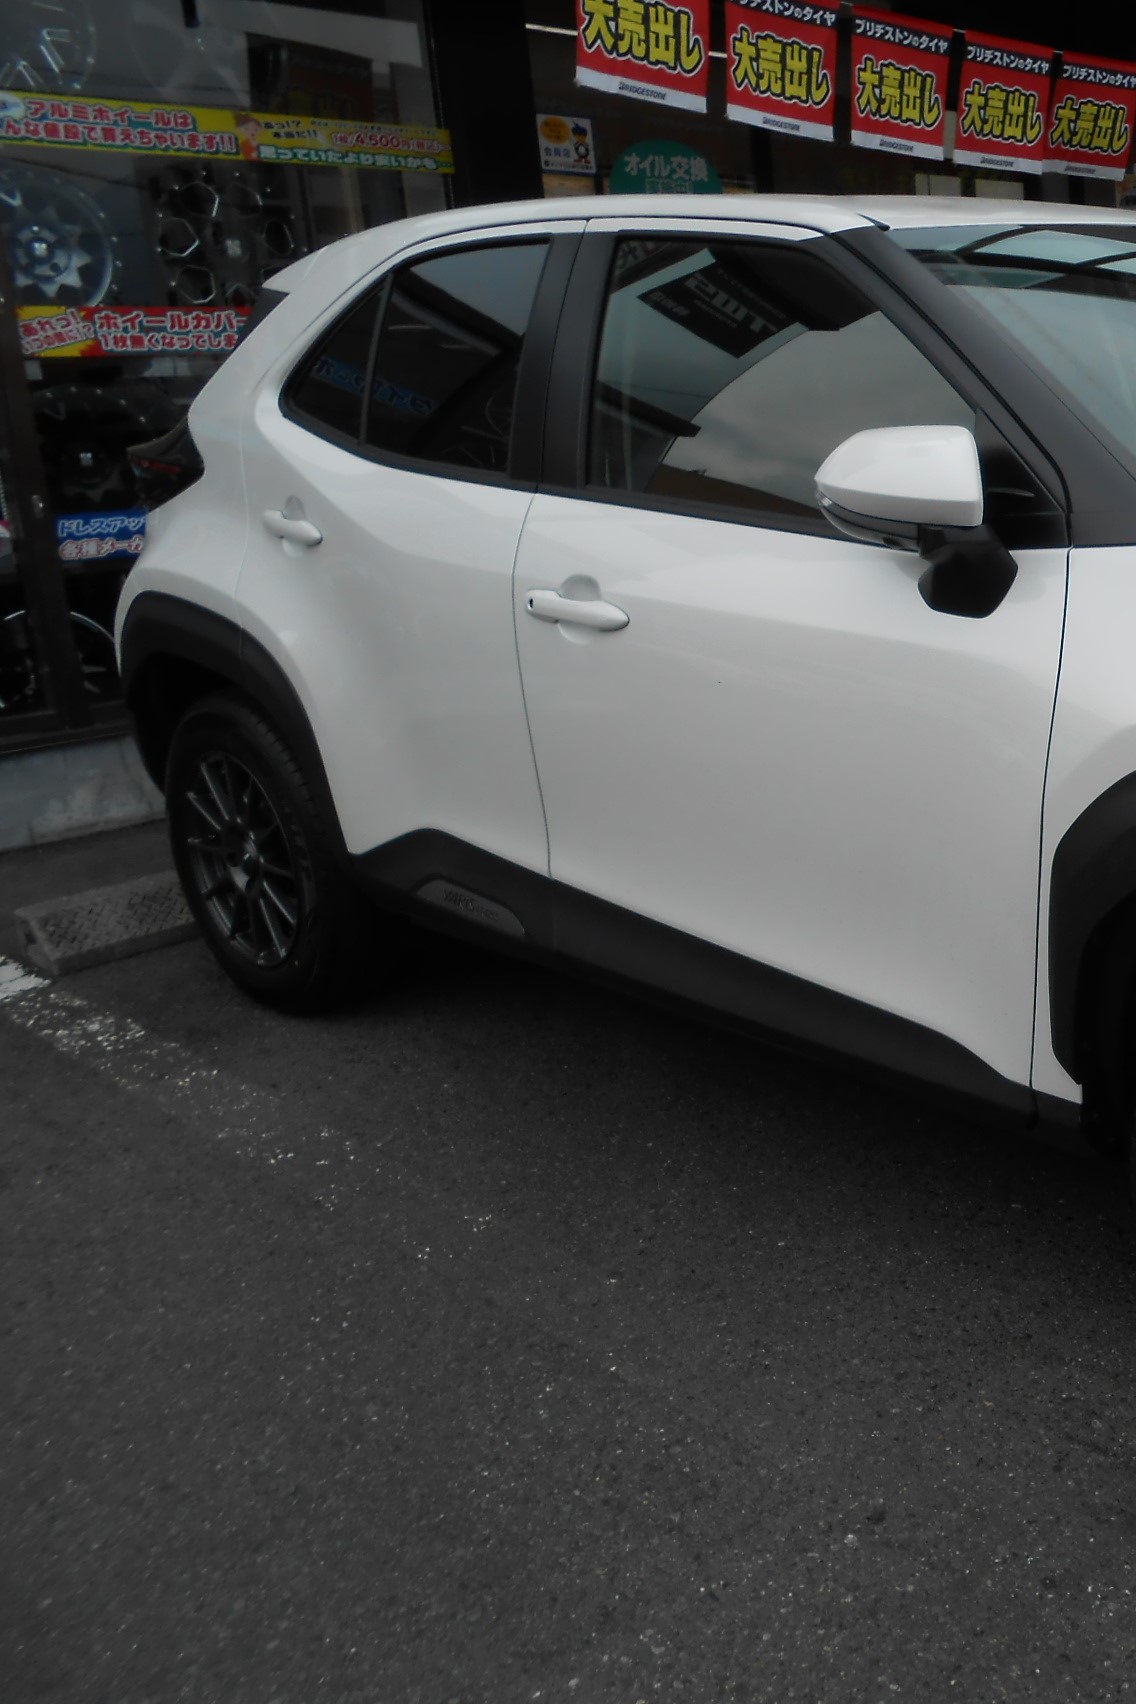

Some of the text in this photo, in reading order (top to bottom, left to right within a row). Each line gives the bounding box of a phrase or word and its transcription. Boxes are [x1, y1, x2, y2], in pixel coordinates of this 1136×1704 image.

[581, 0, 704, 77] 大売出し
[738, 0, 836, 27] ヂストンのタイヤ
[618, 81, 667, 101] BRIDGESTONE
[731, 24, 831, 108] 大売出し
[856, 54, 942, 131] 大売出し
[27, 100, 192, 128] アルミホイールは
[961, 78, 1043, 147] 大売出し
[1050, 94, 1129, 156] 大売出し
[623, 152, 709, 182] オイル交換
